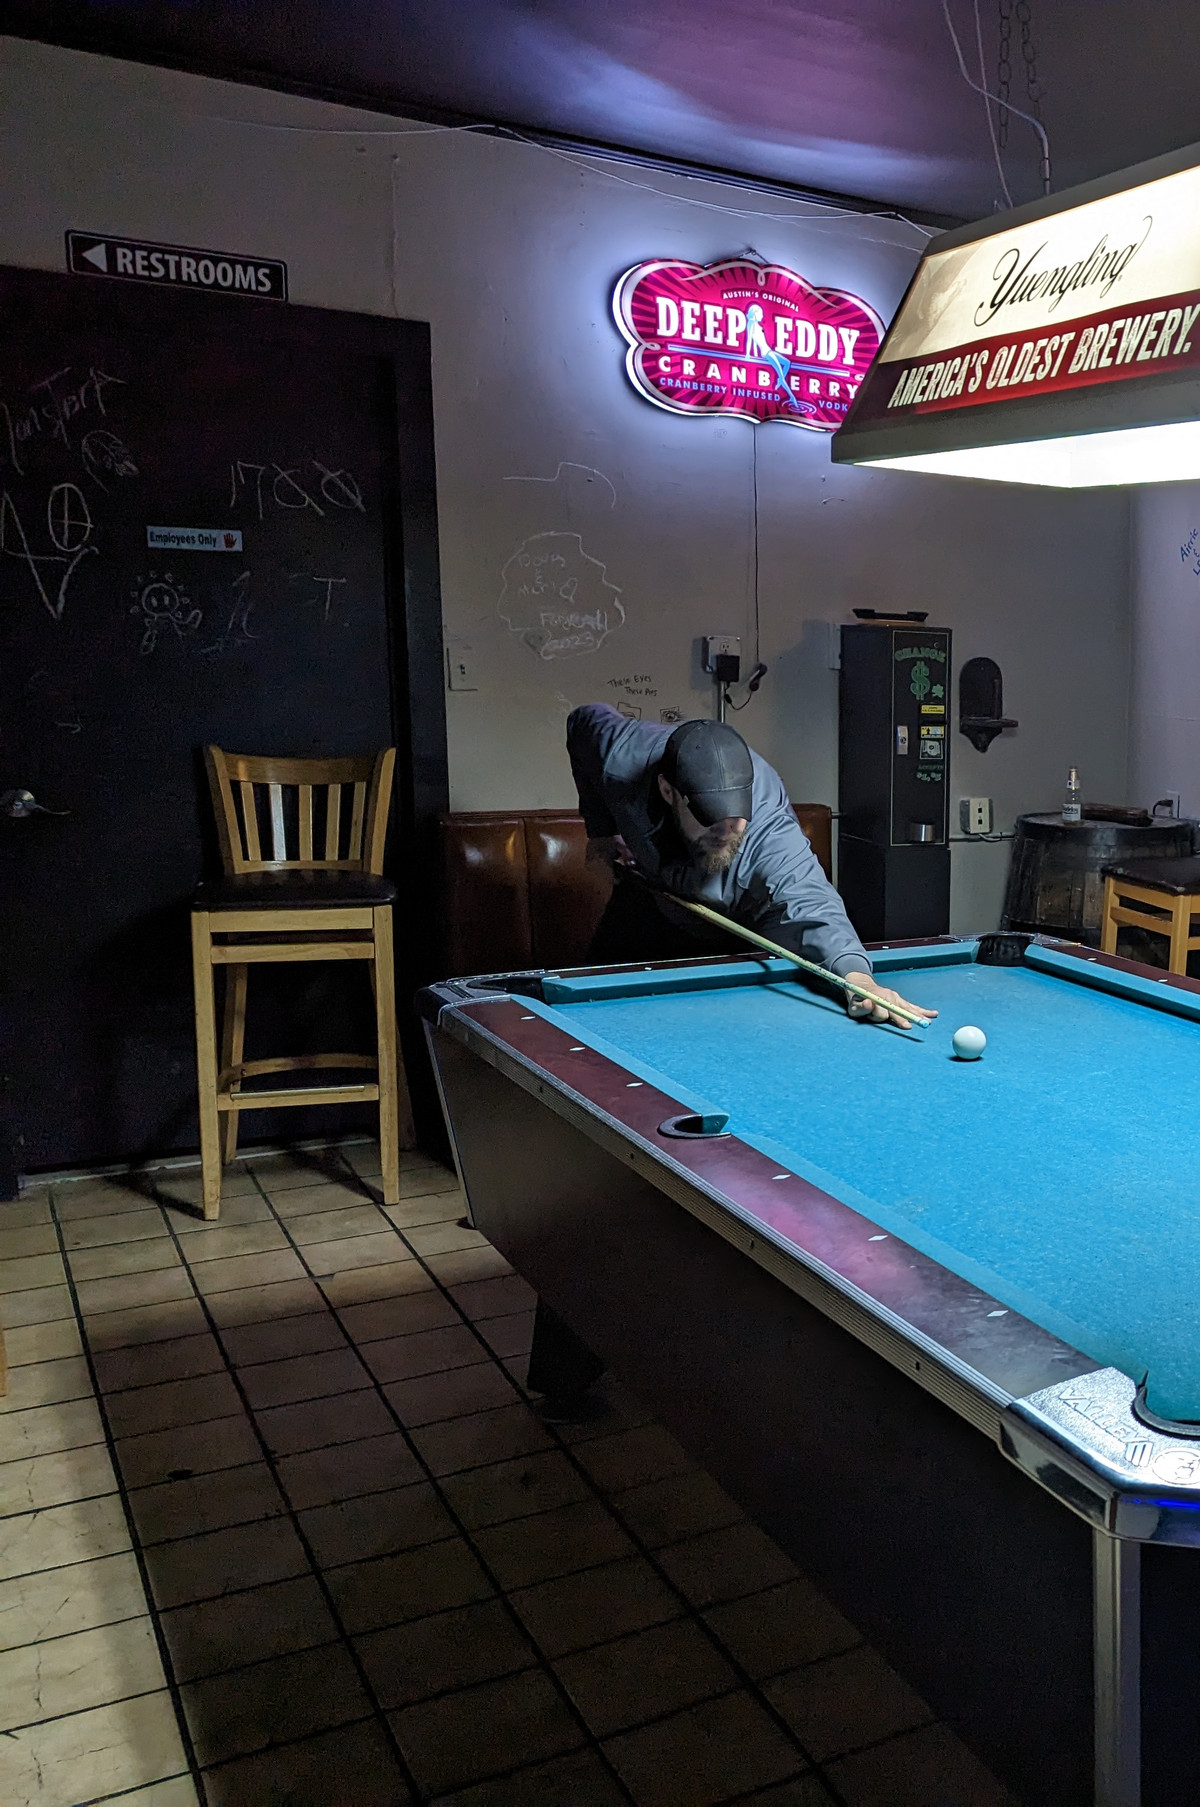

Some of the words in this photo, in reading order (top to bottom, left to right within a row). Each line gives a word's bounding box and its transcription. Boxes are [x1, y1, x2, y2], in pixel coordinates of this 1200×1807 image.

[116, 246, 272, 292] RESTROOMS
[974, 215, 1153, 327] Yuengling
[722, 289, 760, 301] AUSTIN'S
[762, 292, 800, 313] ORIGINAL
[656, 296, 747, 347] DEEP
[774, 315, 860, 366] EDDY
[658, 355, 858, 400] CRANBERRY
[887, 349, 989, 409] AMERICA'S
[986, 331, 1078, 391] OLDEST
[659, 377, 727, 395] CRANBERRY
[732, 388, 781, 402] INFUSED
[818, 400, 849, 412] VODK
[150, 531, 196, 546] Employees
[198, 533, 217, 548] Only
